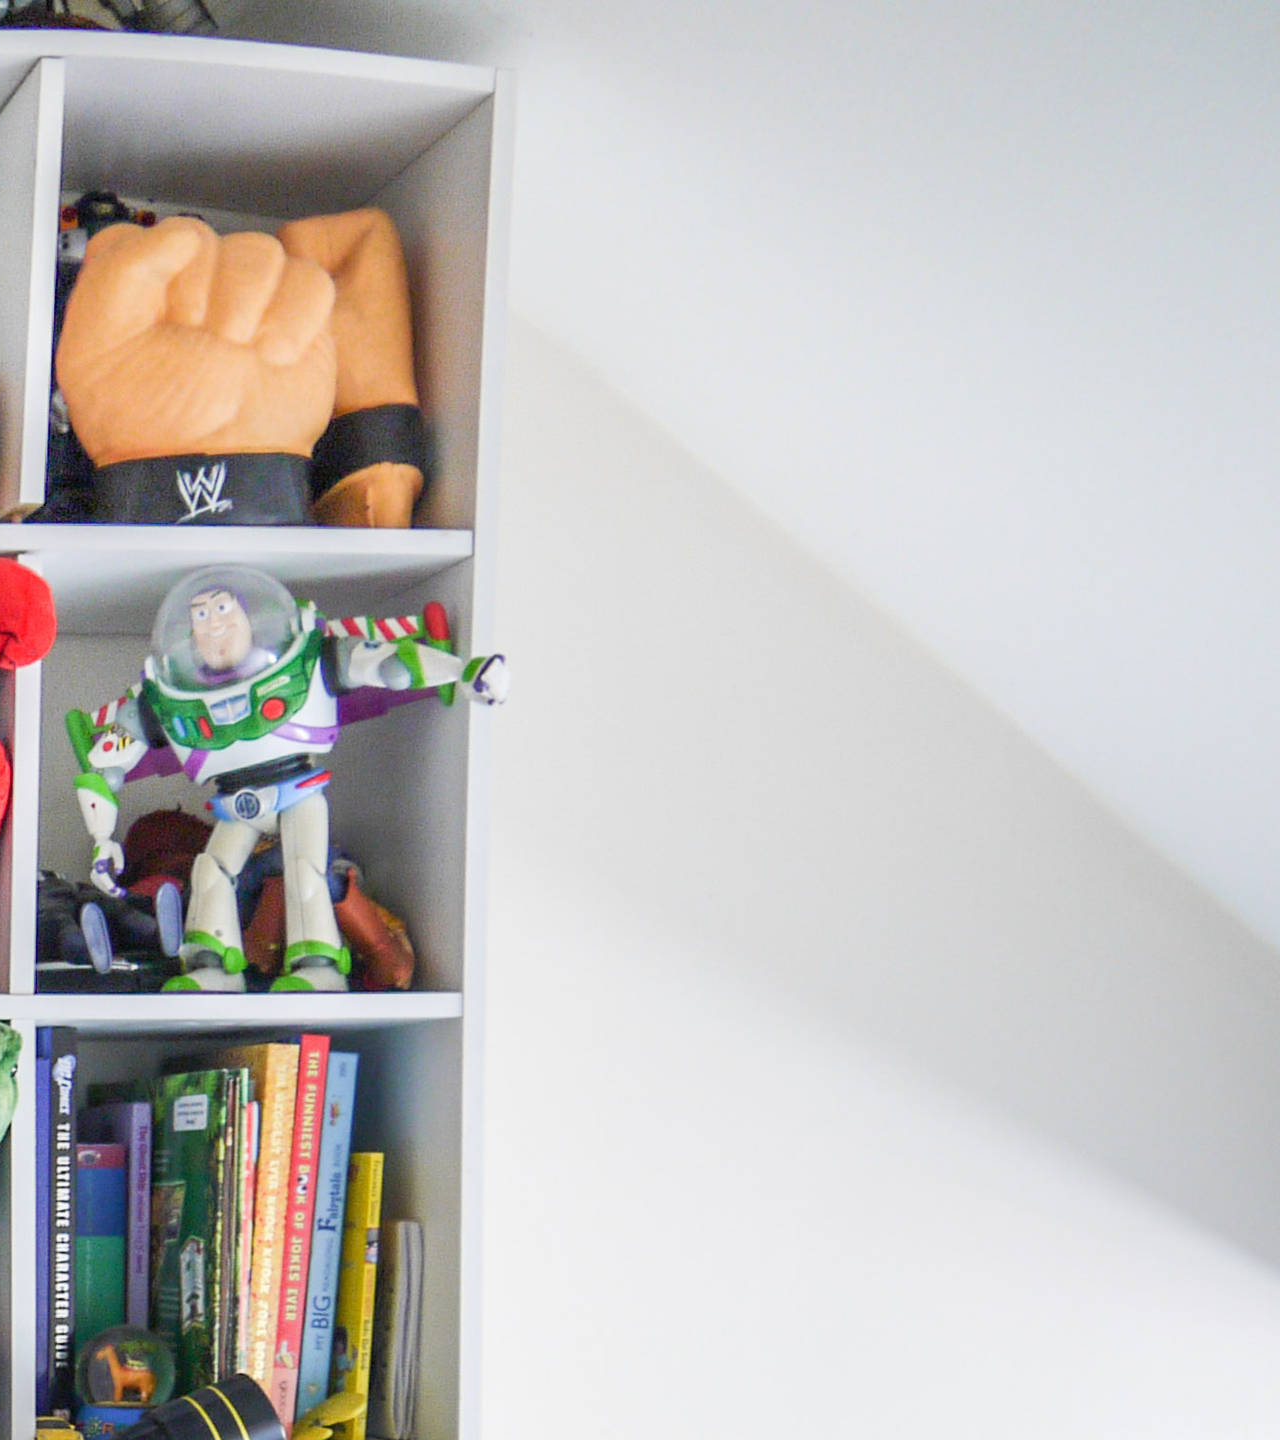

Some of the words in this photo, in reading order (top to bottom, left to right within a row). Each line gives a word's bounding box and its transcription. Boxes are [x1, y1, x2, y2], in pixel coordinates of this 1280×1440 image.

[307, 1050, 321, 1078] THE
[56, 1122, 71, 1151] THE
[299, 1083, 319, 1159] FUNNIEST
[55, 1155, 71, 1228] ULTIMATE
[294, 1164, 310, 1205] BOOK
[263, 1195, 278, 1241] KNOCK
[293, 1212, 306, 1230] OF
[54, 1231, 70, 1318] CHARACTER
[259, 1247, 275, 1294] KNOCK
[288, 1236, 304, 1281] JOKES
[285, 1288, 301, 1322] EVER
[311, 1295, 332, 1330] BIG
[54, 1322, 70, 1368] GUIDE
[252, 1340, 267, 1381] BOOK
